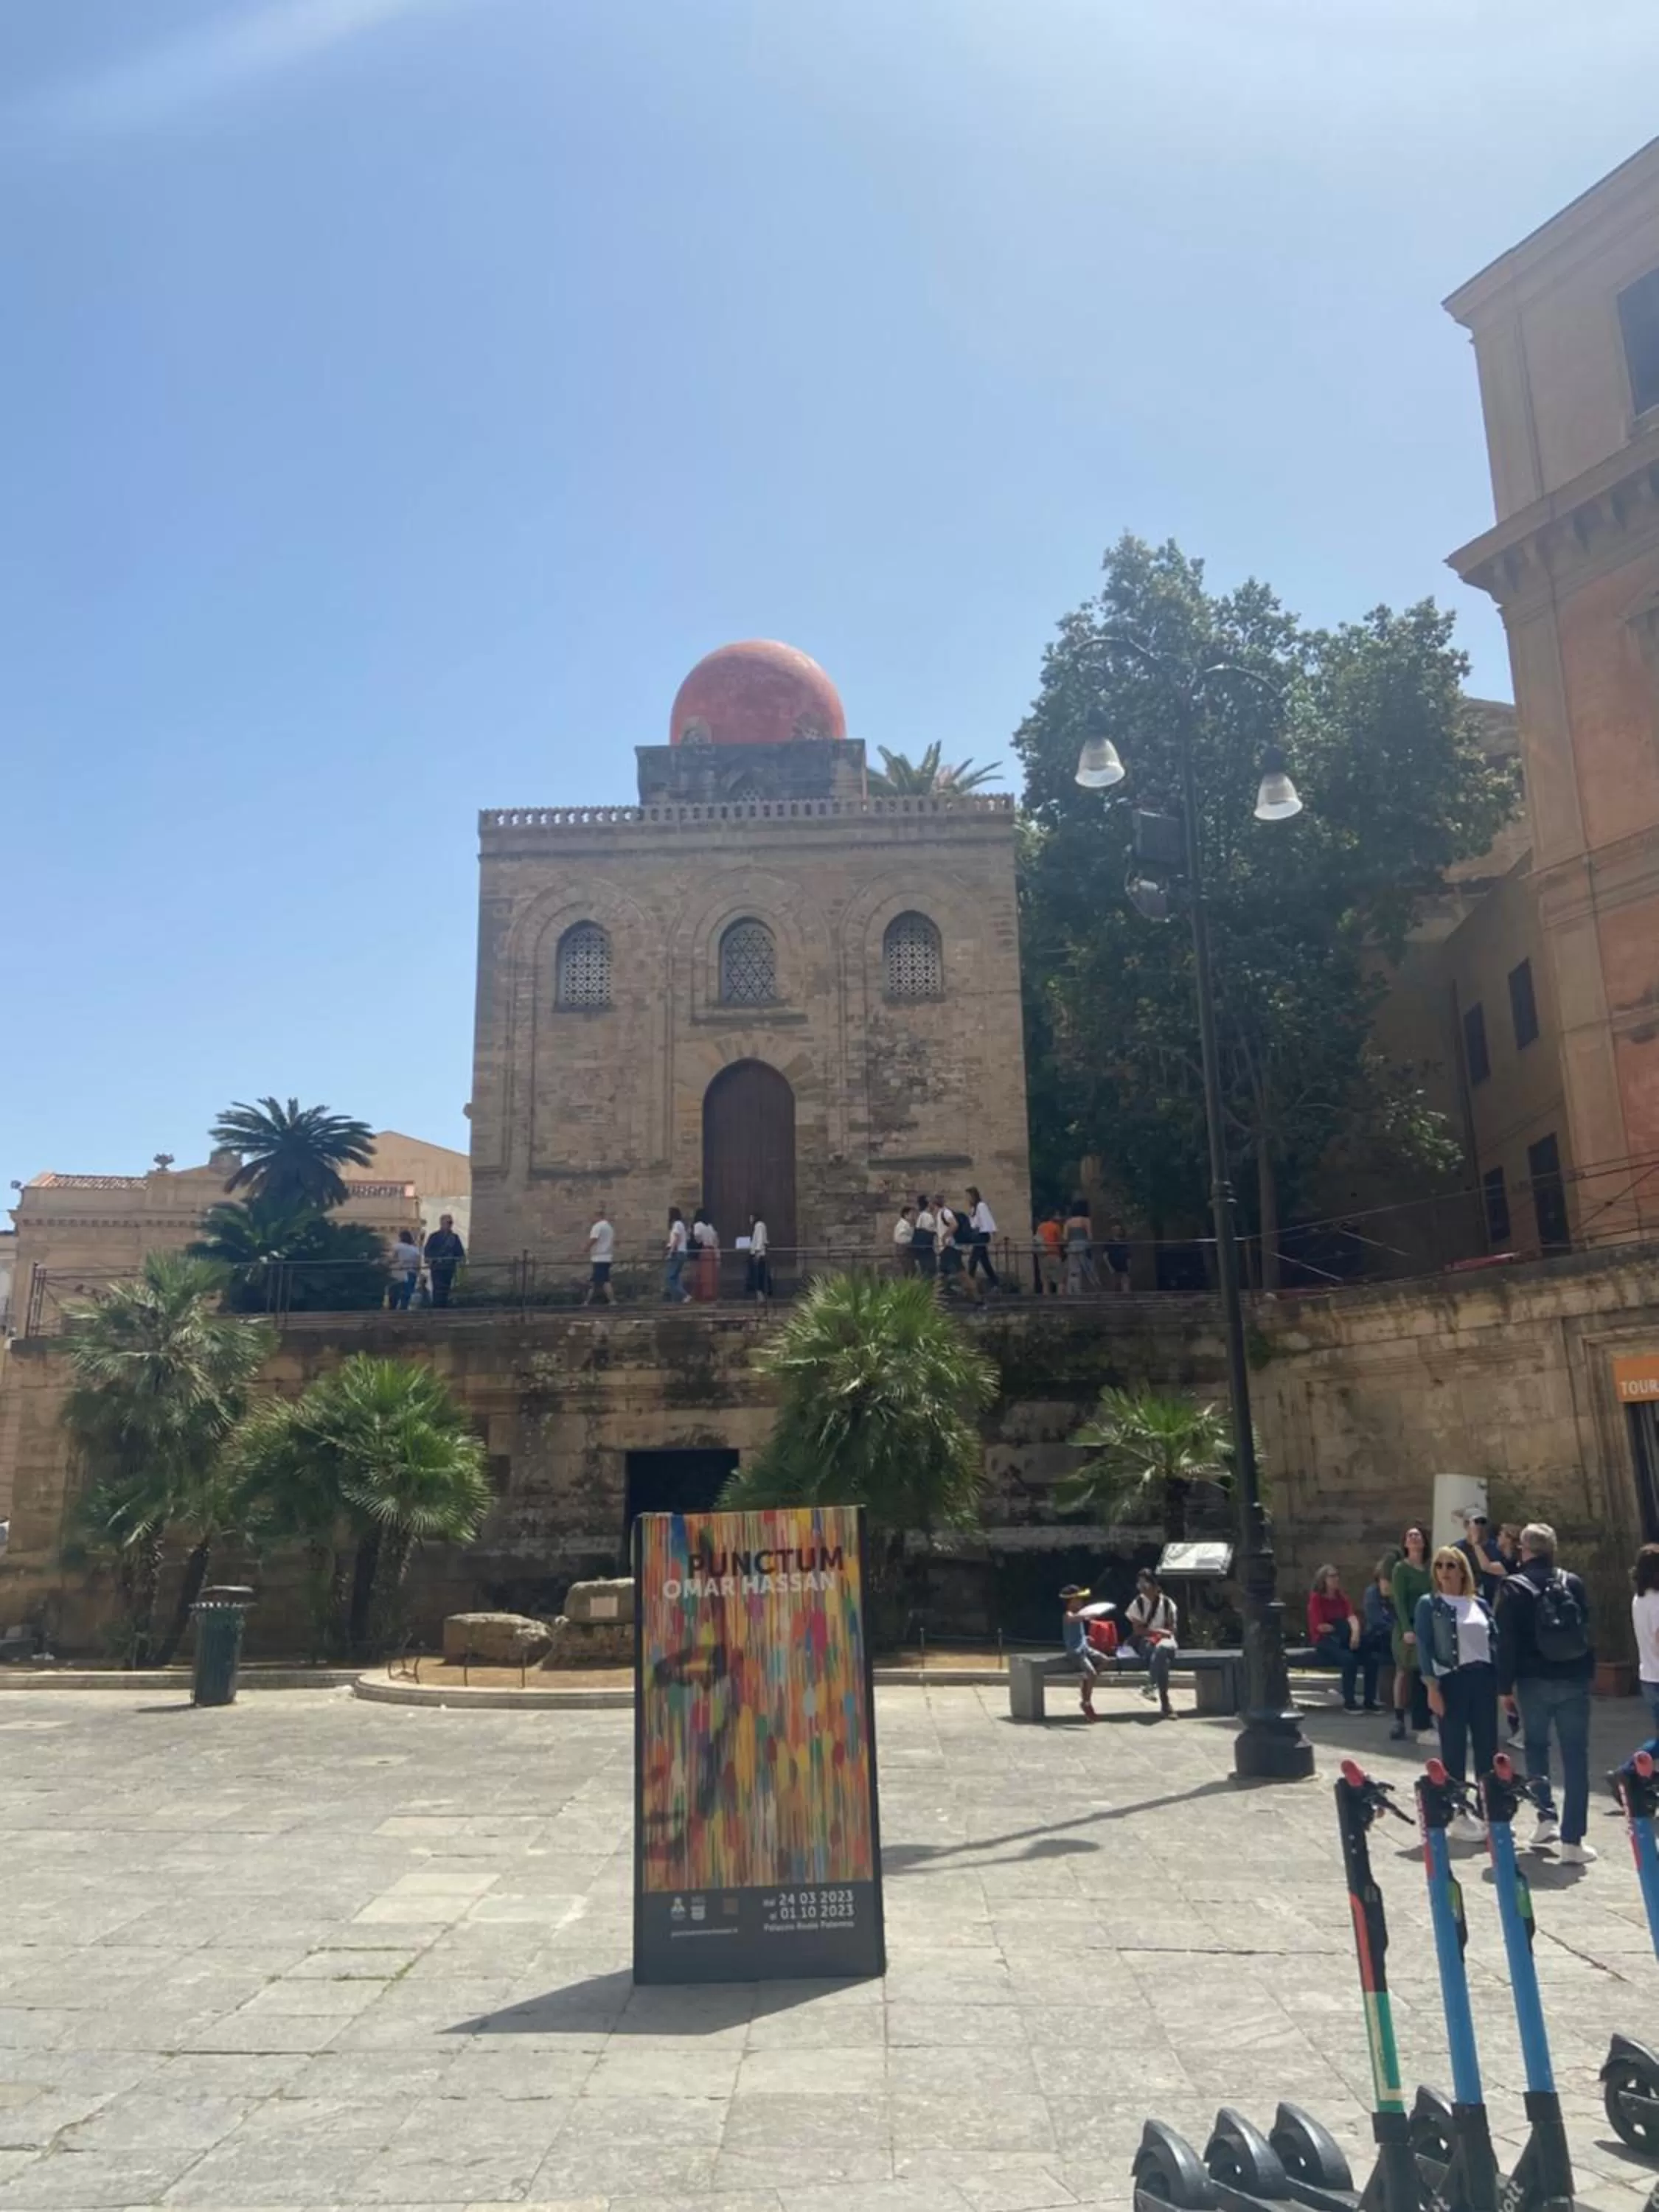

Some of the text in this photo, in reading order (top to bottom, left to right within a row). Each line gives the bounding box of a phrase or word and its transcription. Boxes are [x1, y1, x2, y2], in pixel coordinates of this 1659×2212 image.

[688, 1546, 844, 1578] PUNCTUM
[664, 1571, 835, 1599] OMAR HASSAN
[779, 1893, 795, 1906] 24
[799, 1892, 816, 1905] 03
[820, 1890, 853, 1903] 2023
[780, 1907, 796, 1920] 01
[801, 1905, 816, 1919] 10
[820, 1904, 854, 1918] 2023
[1498, 2180, 1525, 2212] ott
